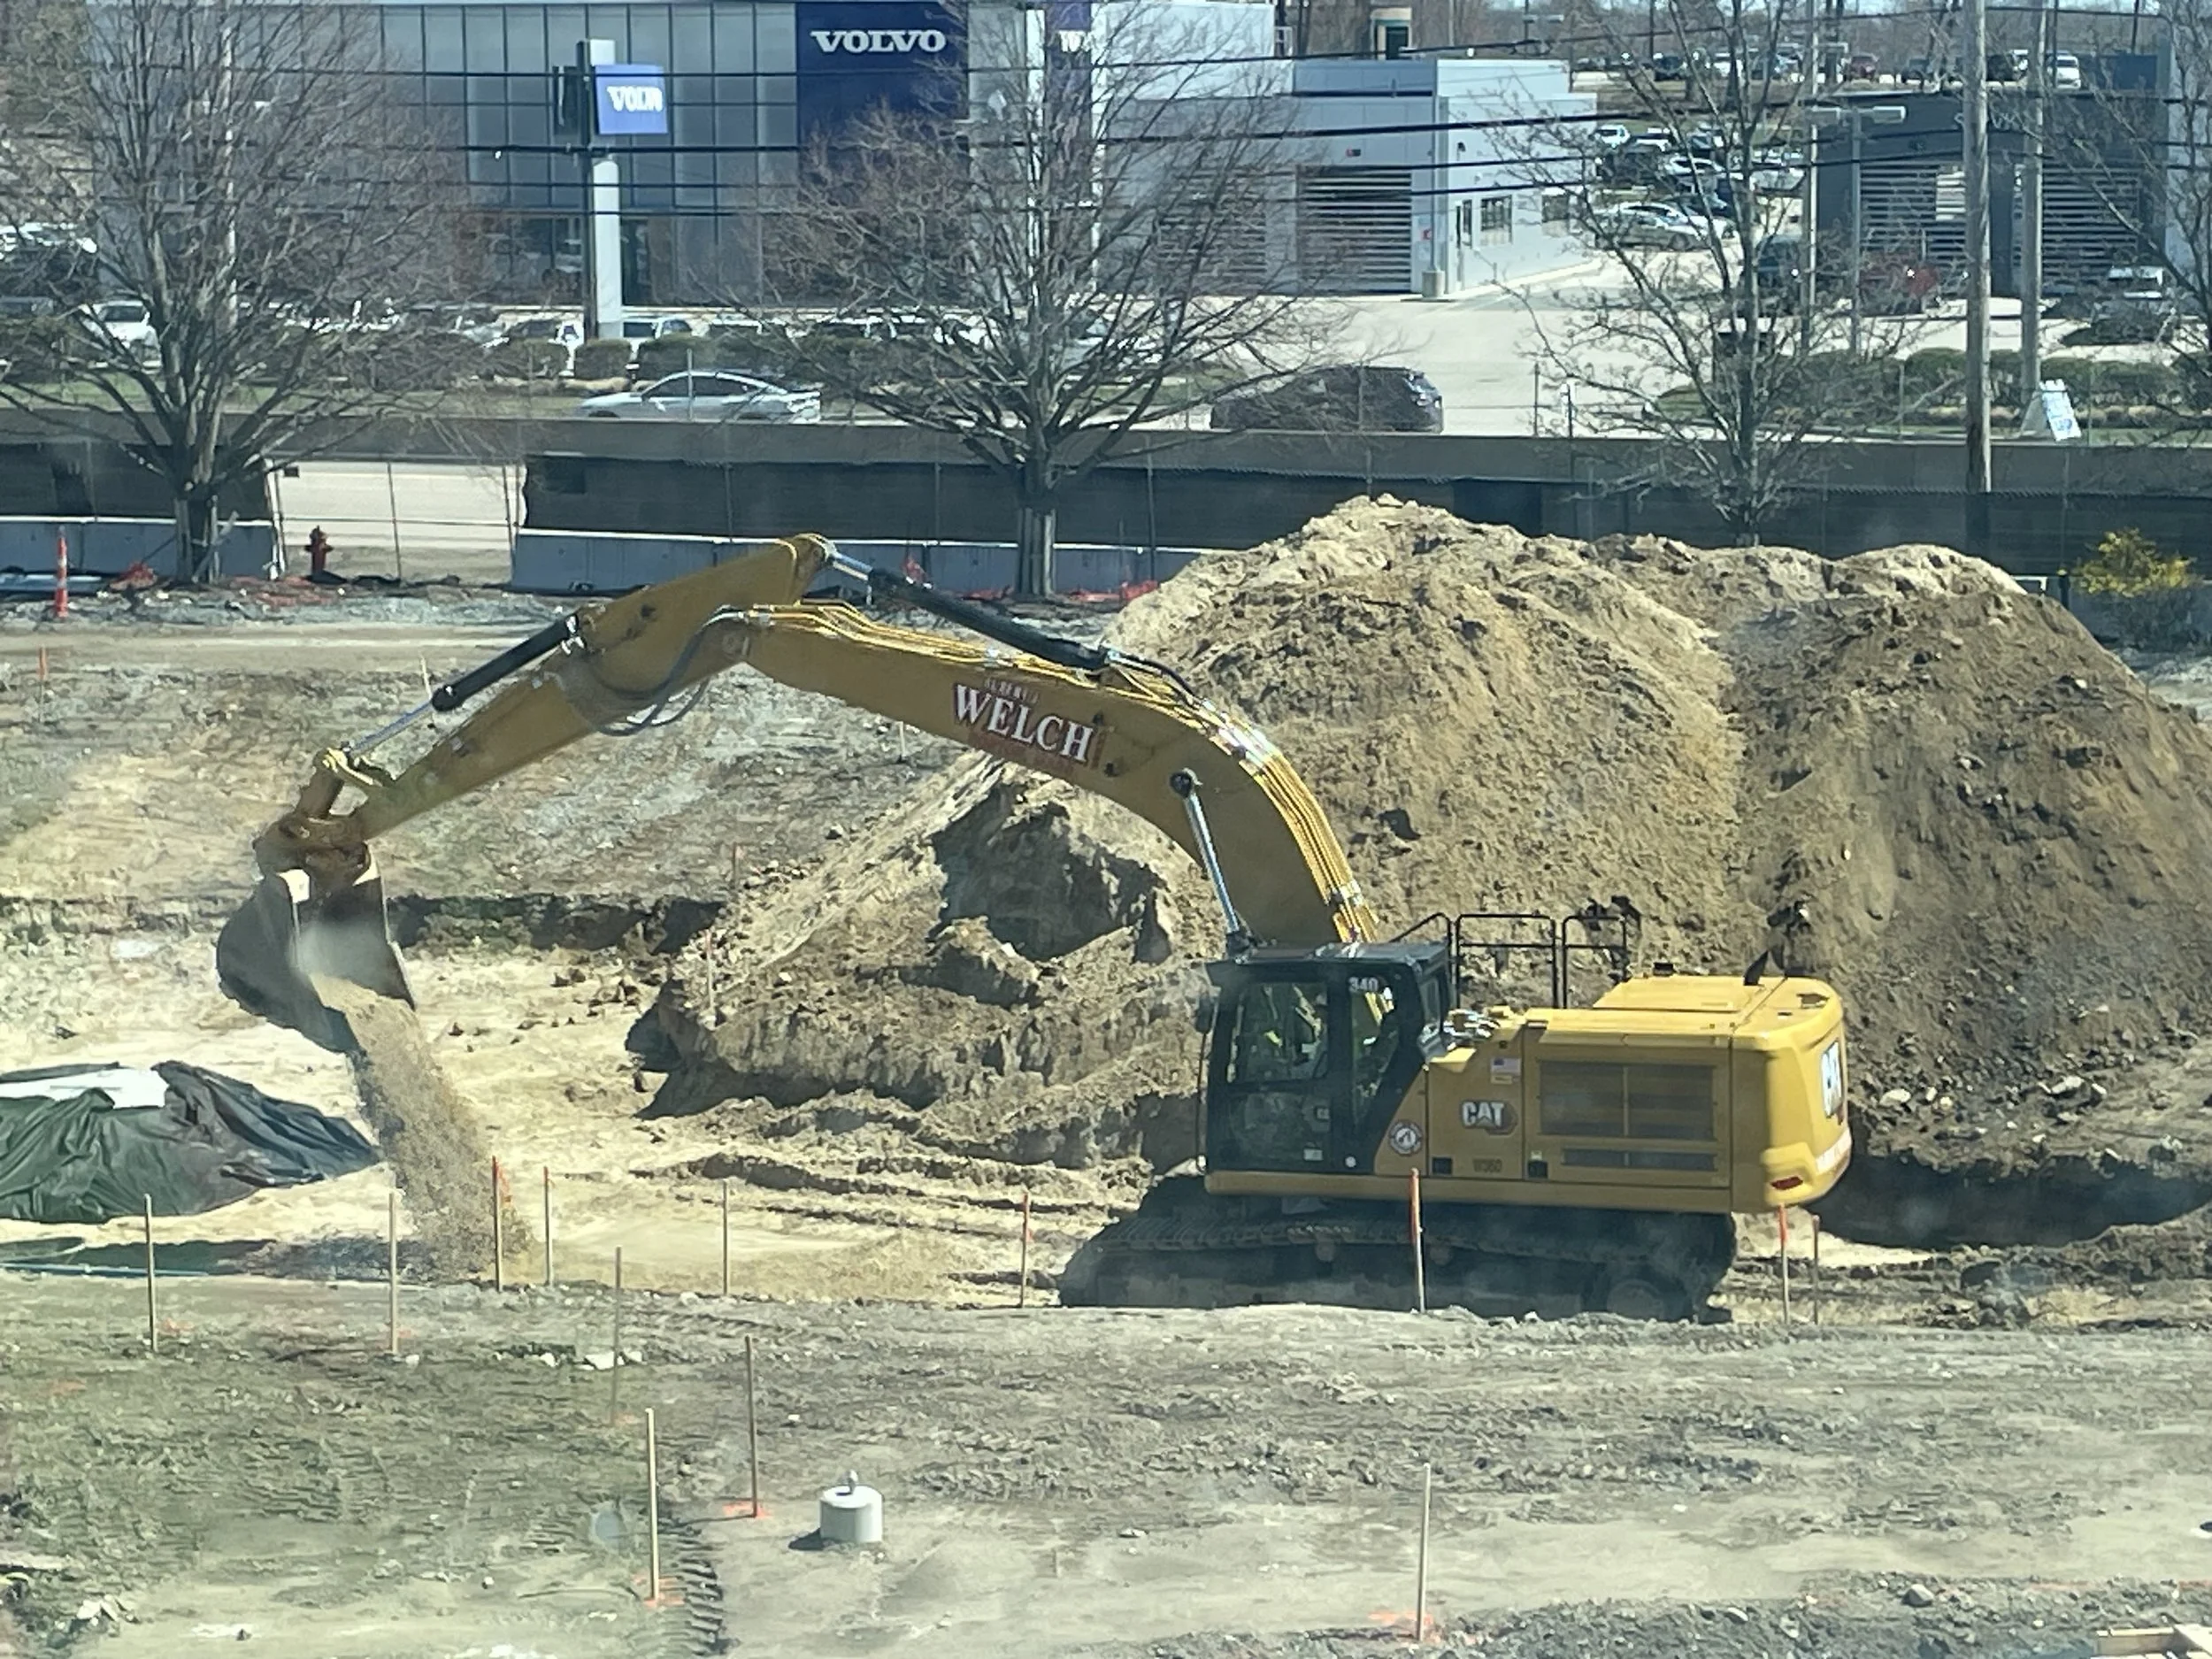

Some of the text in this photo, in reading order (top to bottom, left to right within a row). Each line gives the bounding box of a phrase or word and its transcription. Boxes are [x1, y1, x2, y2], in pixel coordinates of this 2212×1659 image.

[810, 30, 947, 53] VOLVO
[955, 684, 1094, 763] WELCH
[1348, 976, 1379, 993] 340
[1462, 1101, 1505, 1127] CAT
